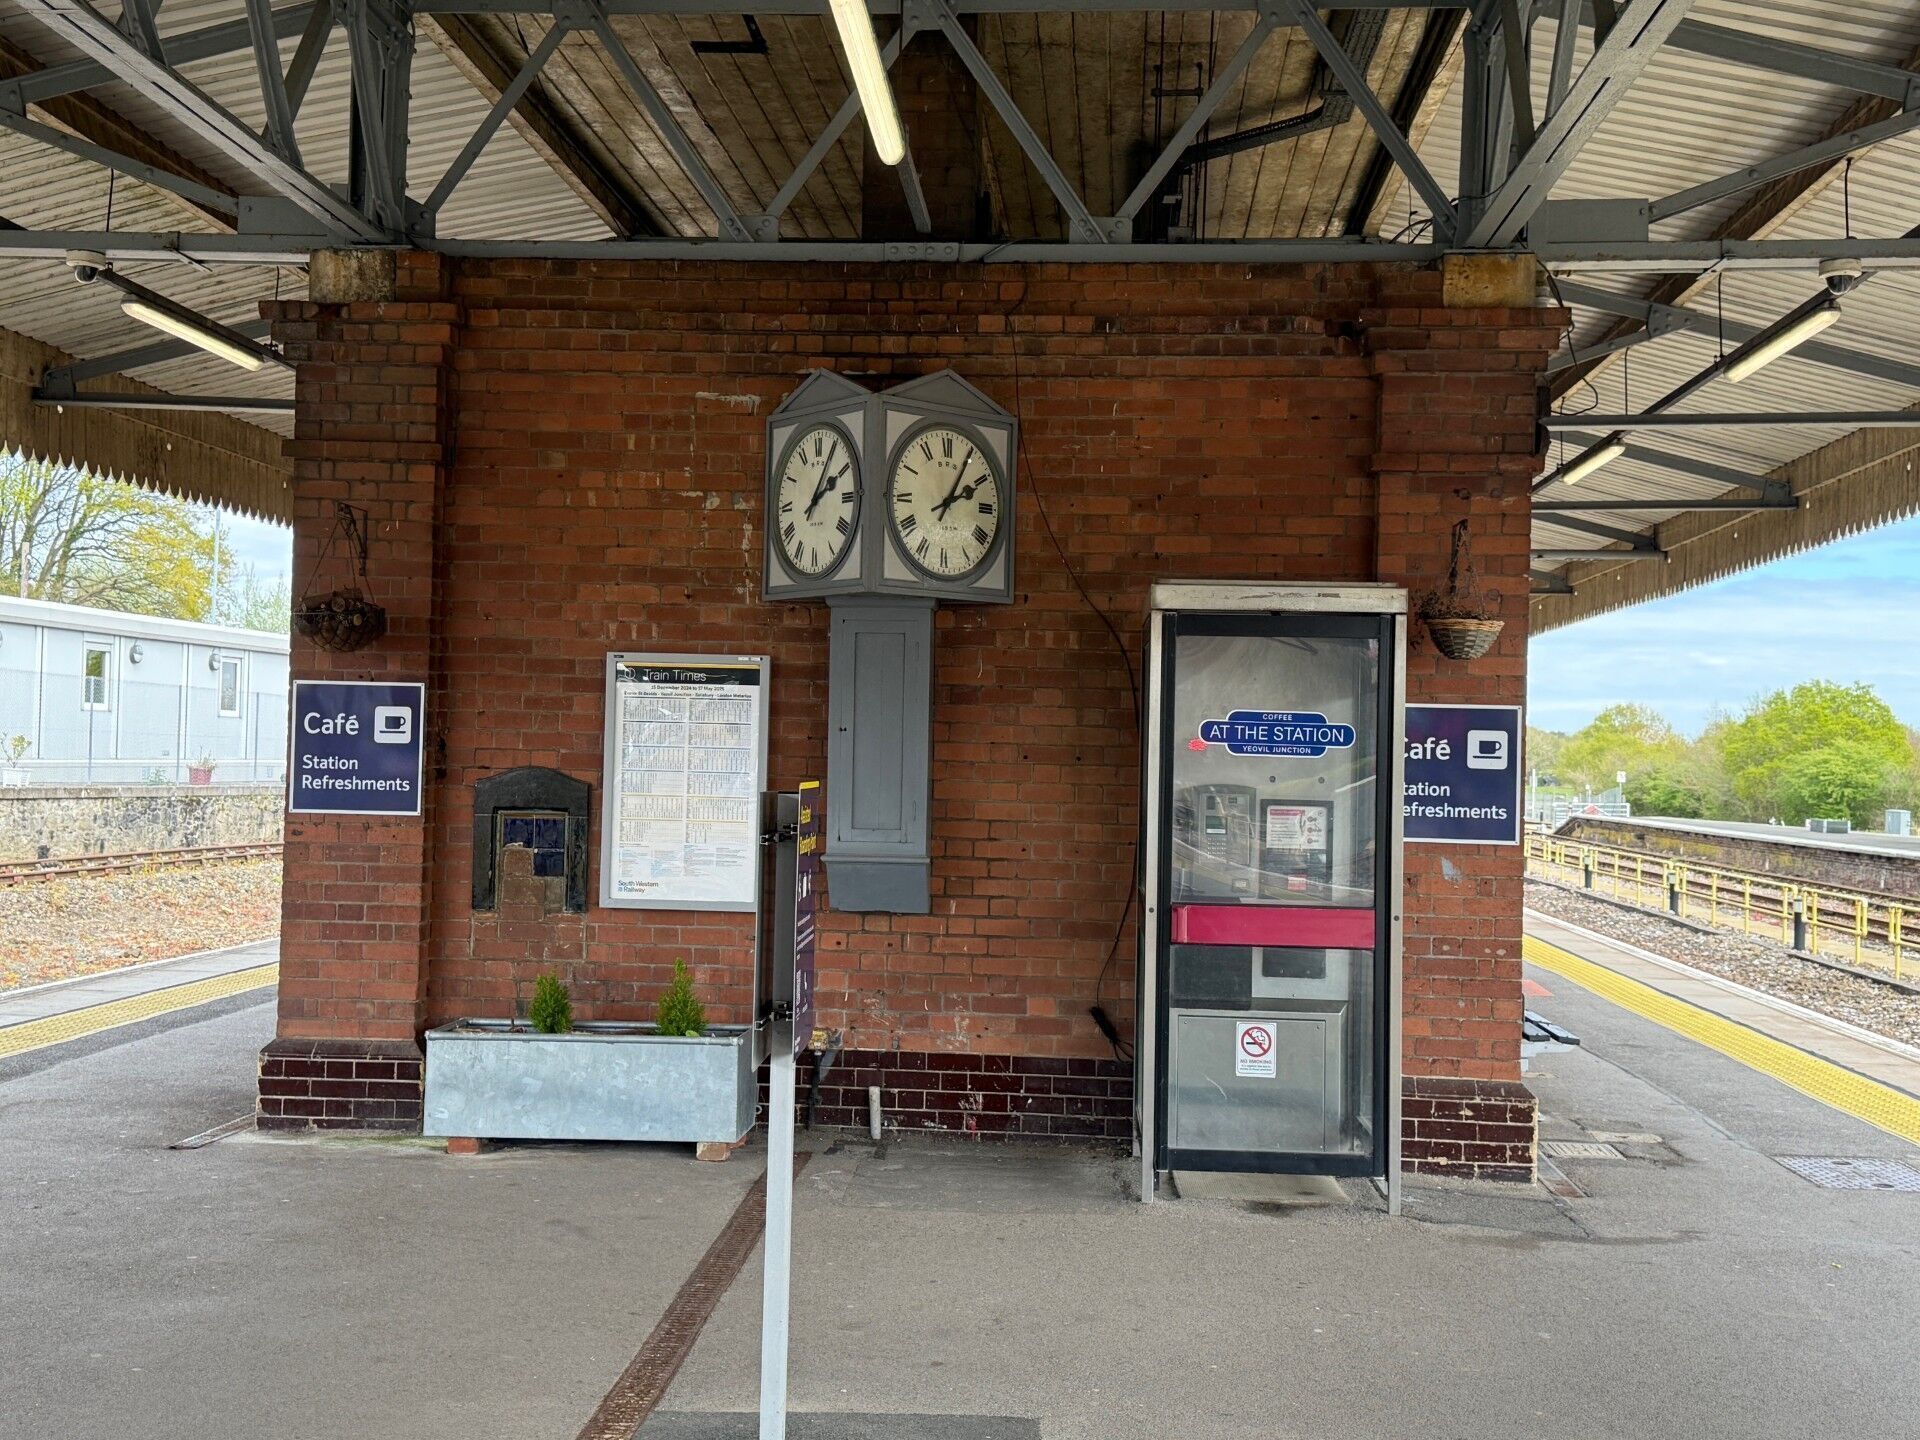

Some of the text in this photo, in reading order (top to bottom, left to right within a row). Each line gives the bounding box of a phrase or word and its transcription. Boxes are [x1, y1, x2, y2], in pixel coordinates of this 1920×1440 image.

[641, 668, 707, 682] Train Times
[303, 711, 360, 735] Café
[1262, 713, 1293, 721] COFFEE
[1209, 725, 1344, 743] AT THE STATION
[1242, 745, 1270, 753] YEOVIL
[302, 754, 358, 770] Station
[302, 774, 410, 791] Refreshments
[1404, 782, 1451, 797] tation
[1403, 802, 1508, 820] efreshments
